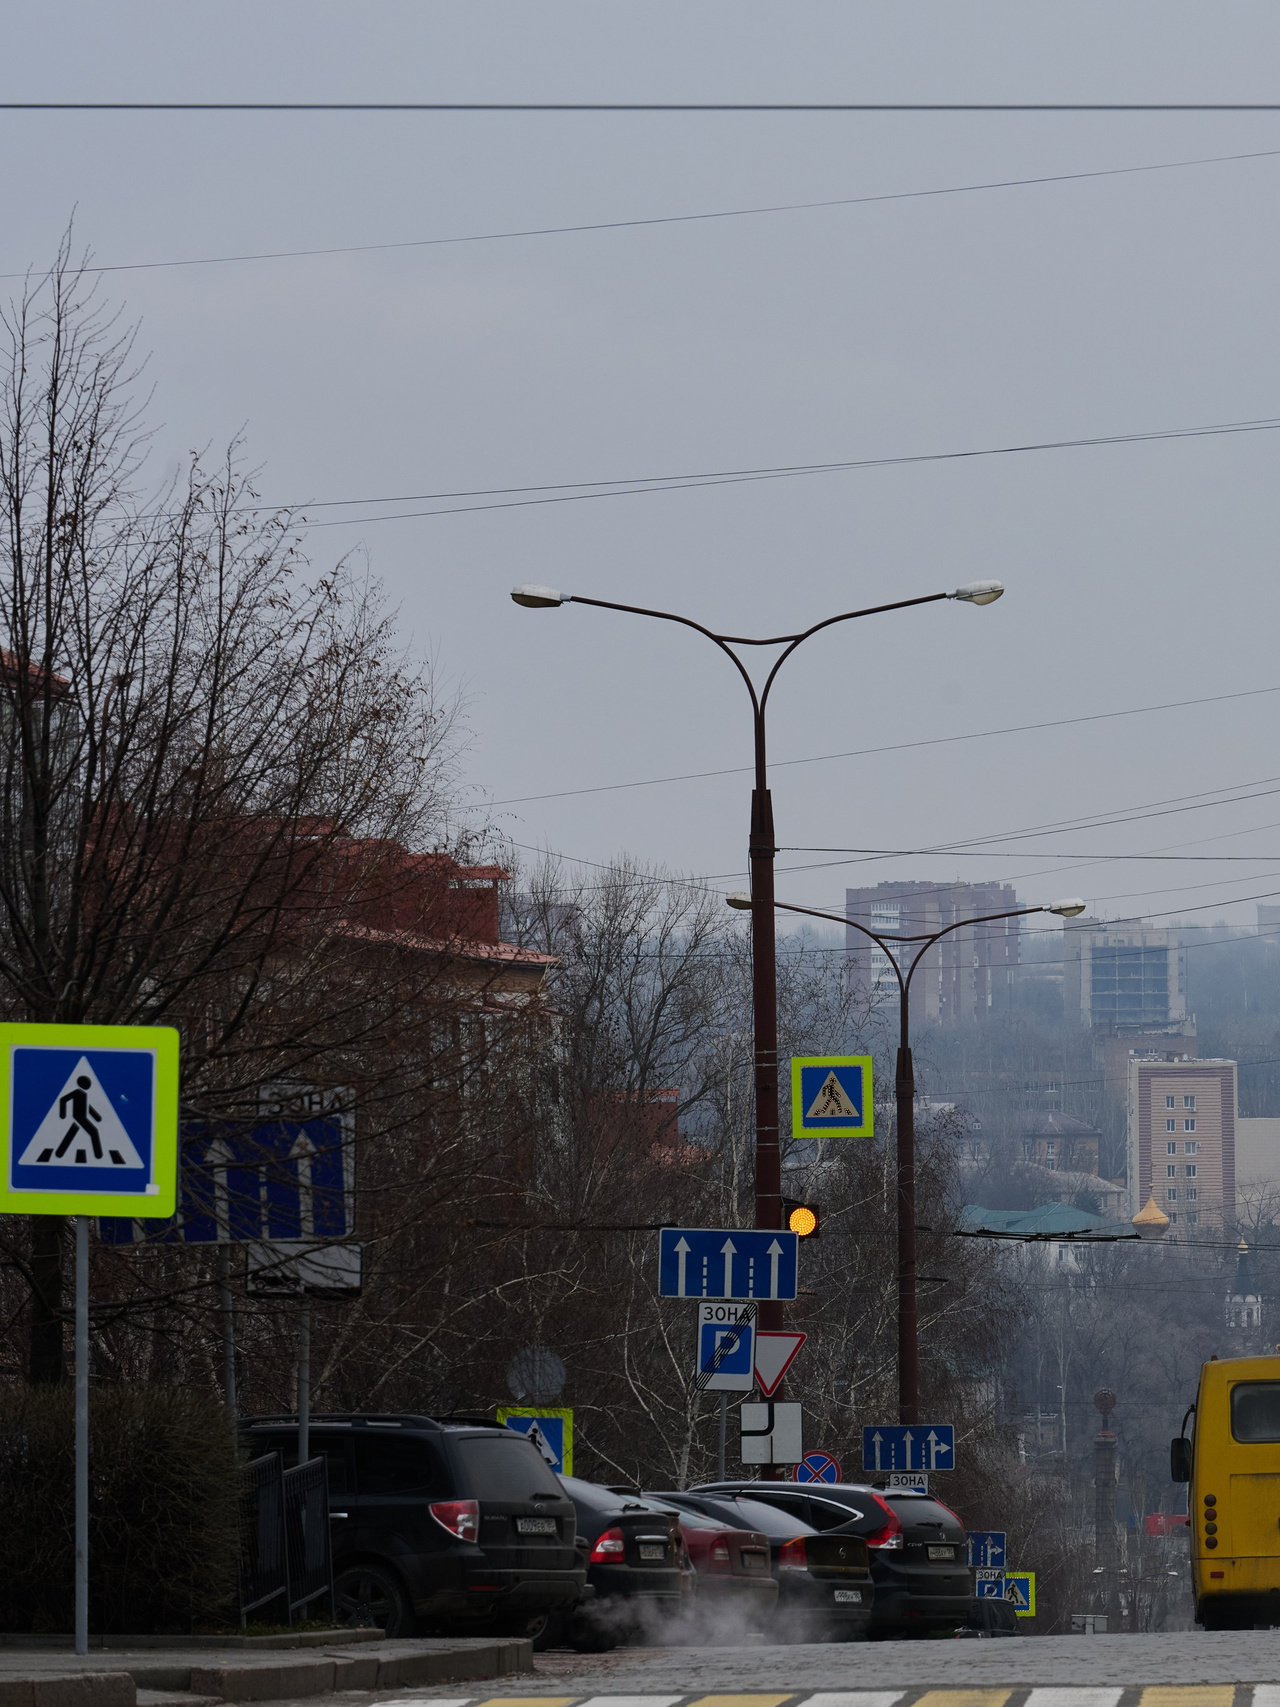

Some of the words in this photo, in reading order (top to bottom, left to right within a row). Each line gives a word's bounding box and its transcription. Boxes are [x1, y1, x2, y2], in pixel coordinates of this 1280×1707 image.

[703, 1306, 752, 1321] ЗОНА
[893, 1475, 925, 1486] ЗОНА
[978, 1571, 1004, 1579] ЗОНА
